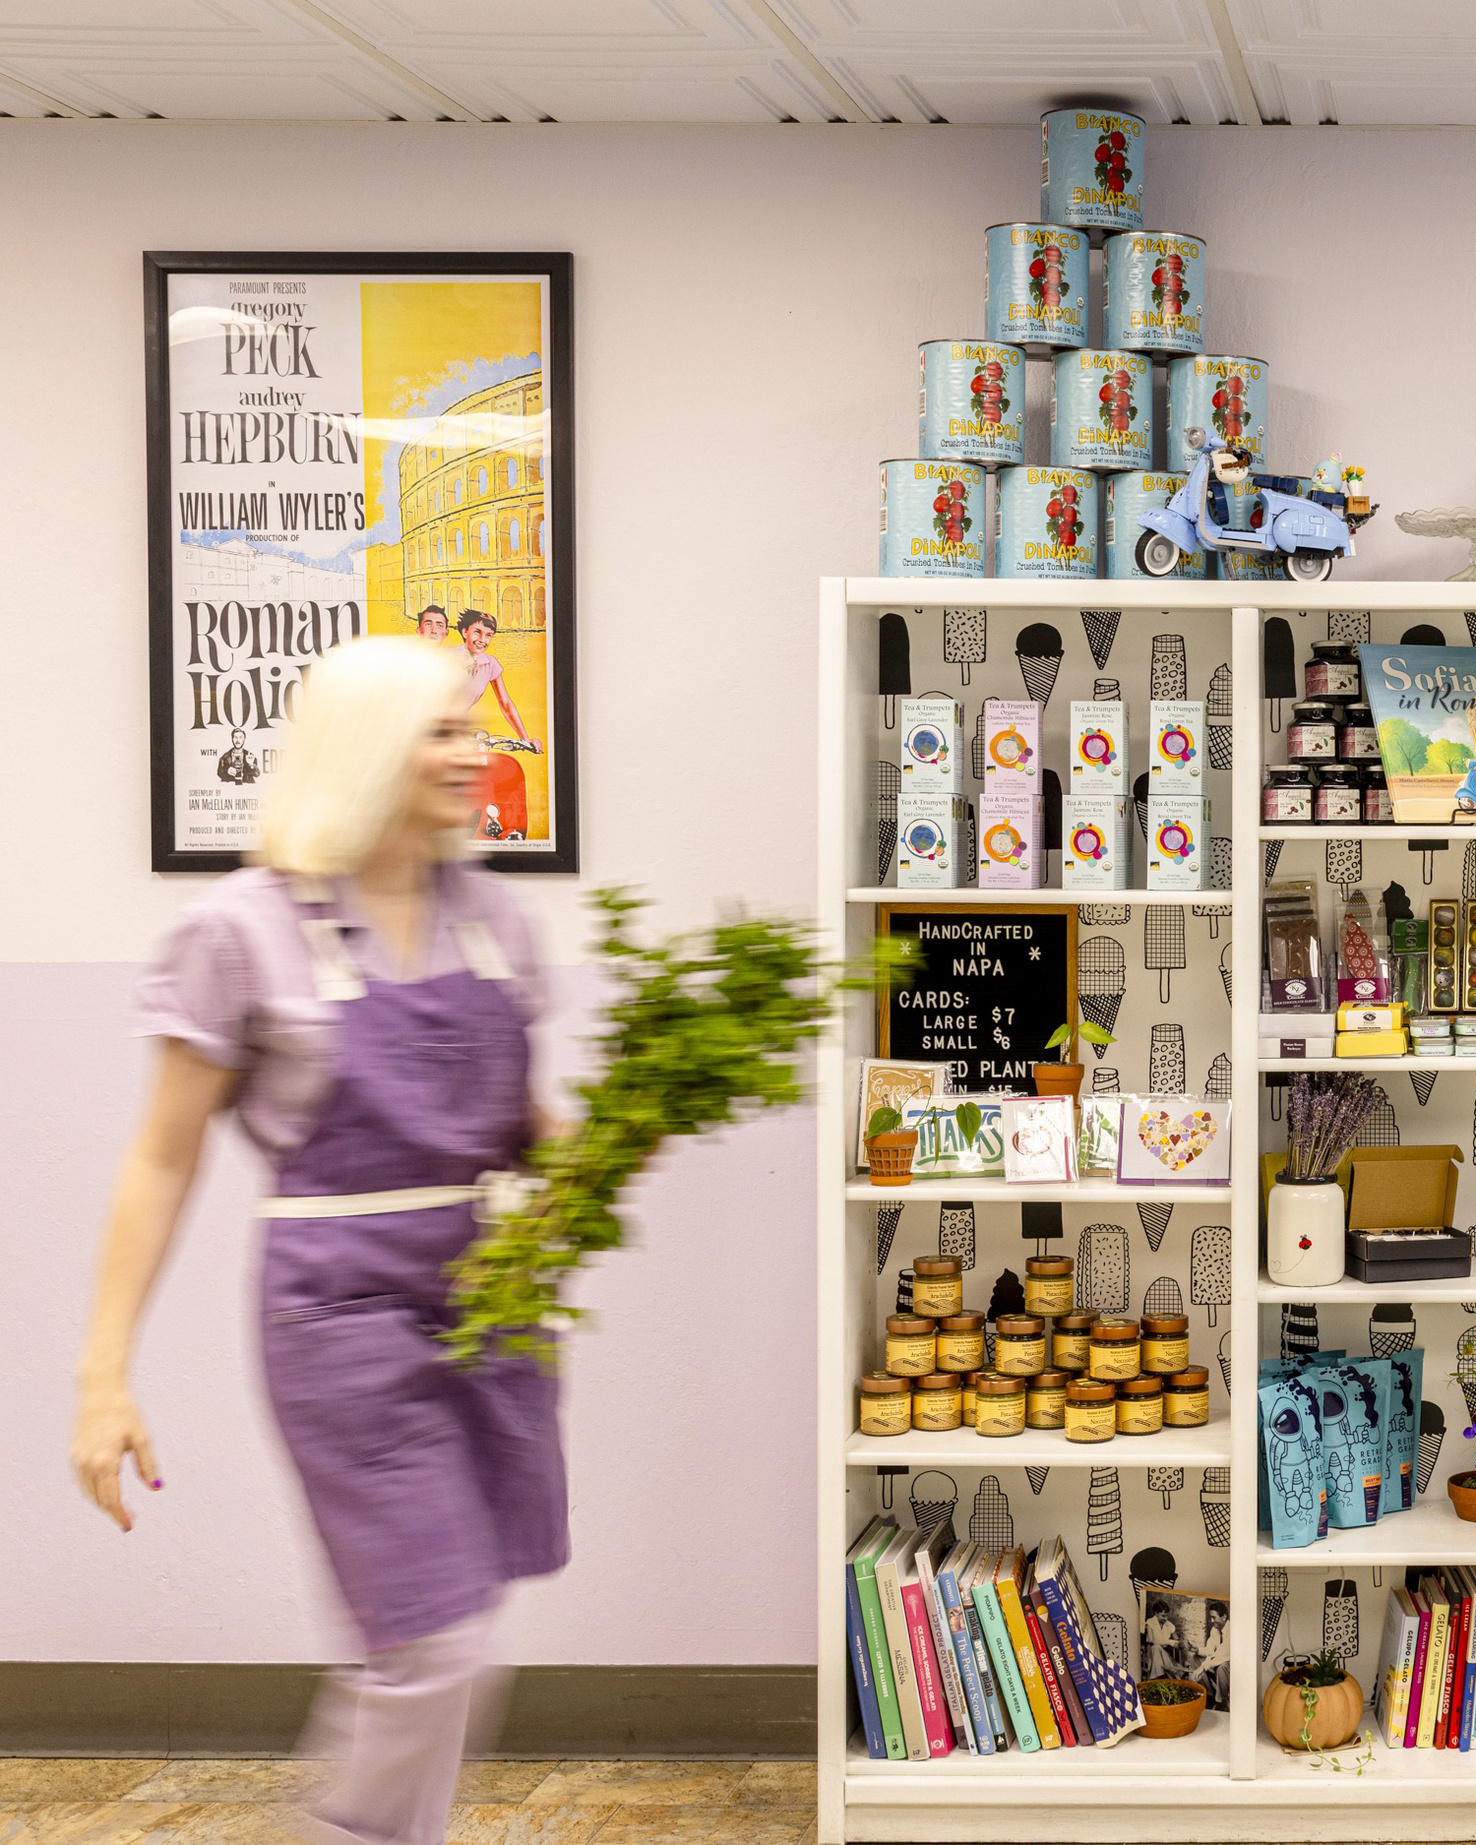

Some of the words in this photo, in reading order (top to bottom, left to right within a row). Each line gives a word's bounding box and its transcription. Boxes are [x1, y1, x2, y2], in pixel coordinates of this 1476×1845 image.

[1076, 113, 1141, 137] BIANCO
[1011, 229, 1080, 249] BIANCO
[1133, 237, 1199, 259] BIANCO
[229, 282, 269, 294] PARAMOUNT
[272, 282, 306, 294] PRESENTS
[230, 301, 308, 322] gregory
[219, 323, 323, 379] PECK
[952, 344, 1020, 366] BIANCO
[1080, 354, 1146, 374] BIANCO
[1194, 361, 1261, 380] BIANCO
[239, 387, 306, 410] audrey
[179, 411, 363, 465] HEPBURN
[914, 464, 981, 484] BIANCO
[1027, 469, 1093, 488] BIANCO
[179, 492, 269, 531] WILLIAM
[278, 491, 365, 531] WYLER'S
[245, 534, 287, 542] PRODUCTION
[290, 534, 300, 542] OF
[184, 664, 312, 731] Holid
[1399, 695, 1420, 710] in
[188, 799, 200, 811] IAN
[970, 942, 986, 956] IN
[953, 959, 1005, 976] NAPA
[899, 991, 970, 1009] CARDS:
[923, 1015, 978, 1029] LARGE
[991, 1006, 1016, 1025] $7
[922, 1035, 978, 1050] SMALL
[980, 1061, 1046, 1078] PLANT
[931, 1614, 946, 1648] PROJECT
[968, 1611, 980, 1641] making
[1435, 1613, 1446, 1647] GELATO
[1056, 1621, 1076, 1662] Gelato
[1405, 1630, 1414, 1656] GELUPO
[940, 1649, 952, 1678] GELATO
[974, 1640, 988, 1671] artisan
[1051, 1645, 1065, 1676] Gelato
[957, 1638, 967, 1656] The
[962, 1657, 976, 1692] Perfect
[970, 1693, 982, 1722] Scoop
[996, 1637, 1006, 1660] GELATO
[1002, 1659, 1010, 1675] EIGHT
[1006, 1675, 1015, 1690] DAYS
[1012, 1695, 1021, 1714] WEEK
[1402, 1658, 1410, 1684] GELATO
[1446, 1653, 1454, 1684] GELATO
[947, 1678, 959, 1711] ITALIAN
[980, 1671, 994, 1698] gelato
[1040, 1652, 1054, 1682] GELATO
[1049, 1684, 1063, 1712] FIASCO
[1443, 1685, 1451, 1714] FIASCO
